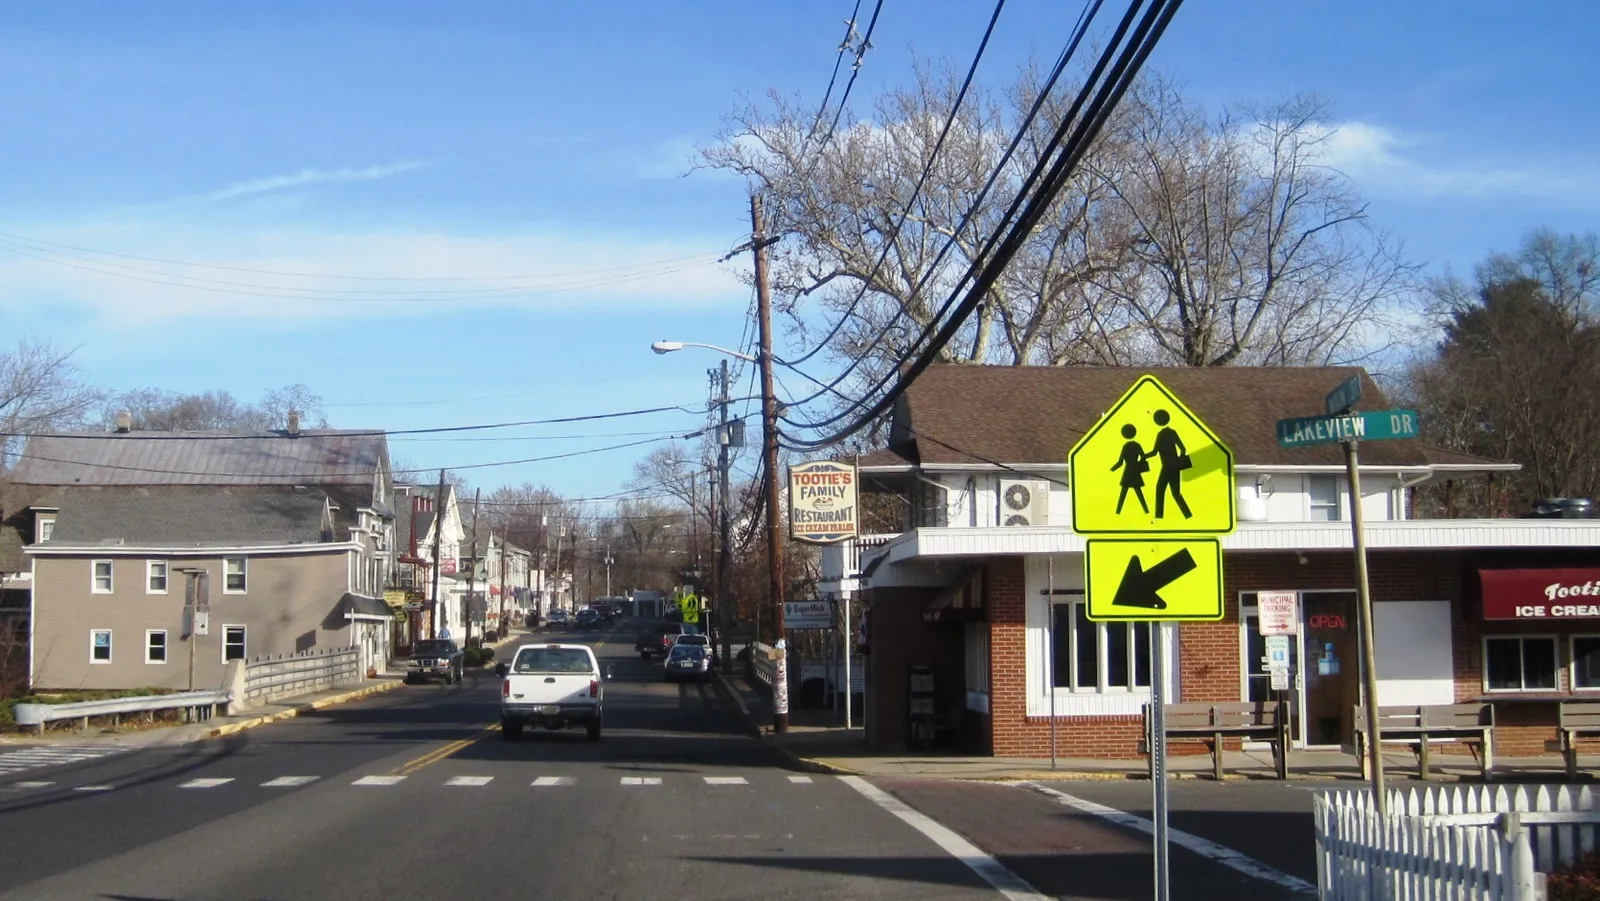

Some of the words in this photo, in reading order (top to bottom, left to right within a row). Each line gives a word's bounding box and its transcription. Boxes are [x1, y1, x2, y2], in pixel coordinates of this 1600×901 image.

[1283, 416, 1365, 442] LAKEVIEW
[1390, 414, 1413, 434] DR
[793, 473, 851, 485] TOOTIE'S
[800, 486, 846, 500] FAMILY
[794, 506, 853, 522] RESTAURANT
[794, 524, 804, 532] ICE
[805, 524, 829, 532] CREAM
[1544, 581, 1600, 600] Tooti
[1261, 595, 1294, 604] MUNICIPAL
[1263, 604, 1291, 612] PARKING
[1515, 606, 1546, 617] ICE
[1550, 605, 1600, 616] CREA
[1309, 615, 1345, 628] OPEN
